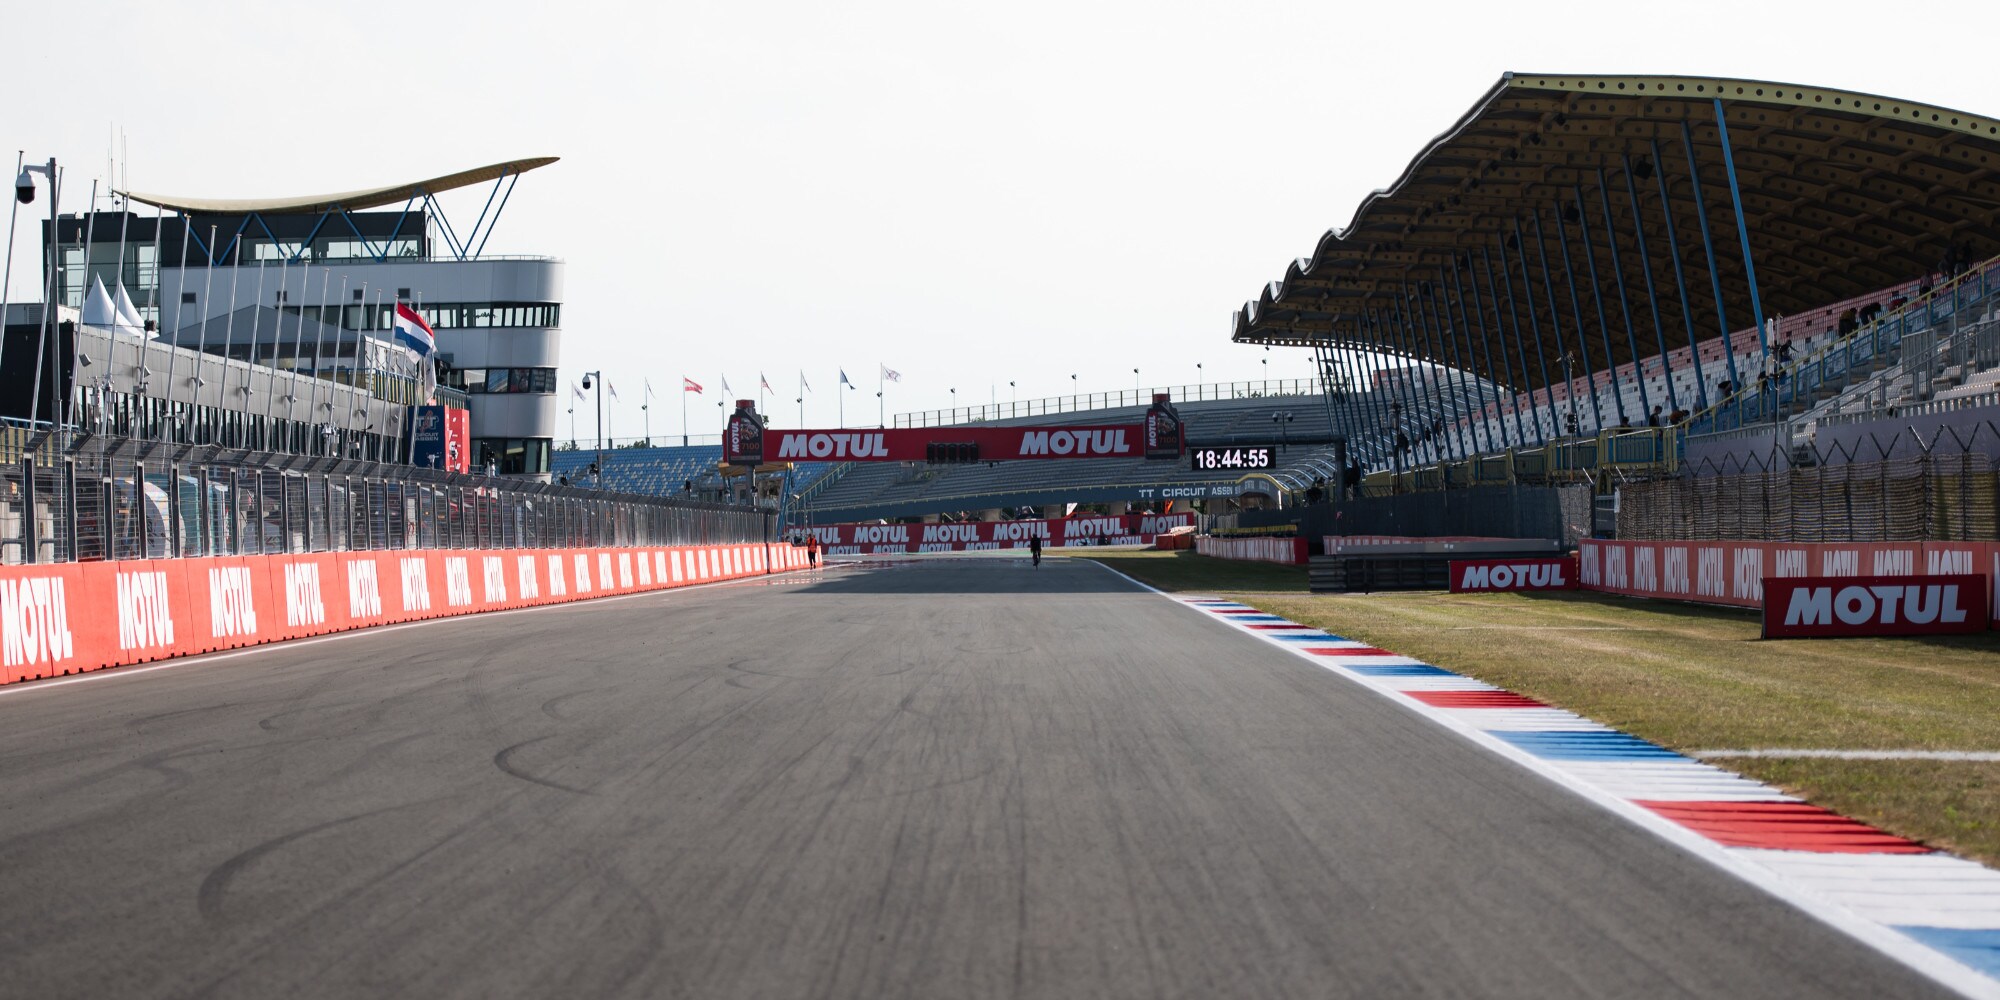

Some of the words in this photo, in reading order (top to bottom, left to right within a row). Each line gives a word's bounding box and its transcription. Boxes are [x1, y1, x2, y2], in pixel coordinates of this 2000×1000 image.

[732, 421, 740, 453] MOTUL
[778, 433, 889, 458] MOTUL
[1019, 430, 1130, 455] MOTUL
[1148, 415, 1157, 447] MOTUL
[1196, 449, 1268, 469] 18:44:55
[1139, 489, 1154, 498] TT
[1162, 487, 1206, 498] CIRCUIT
[854, 526, 909, 544] MOTUL
[923, 525, 980, 543] MOTUL
[993, 522, 1051, 541] MOTUL
[1064, 517, 1123, 538] MOTUL
[872, 544, 908, 554] MOTUL
[1462, 564, 1565, 589] MOTUL
[1605, 545, 1627, 589] MOTUL
[1634, 546, 1657, 592] MOTUL
[1664, 546, 1689, 594] MOTUL
[1697, 547, 1724, 597] MOTUL
[209, 567, 256, 637] MOTUL
[285, 563, 324, 626] MOTUL
[348, 560, 381, 619] MOTUL
[1784, 585, 1967, 625] MOTUL
[0, 576, 73, 667] MOTUL
[117, 571, 174, 649] MOTUL
